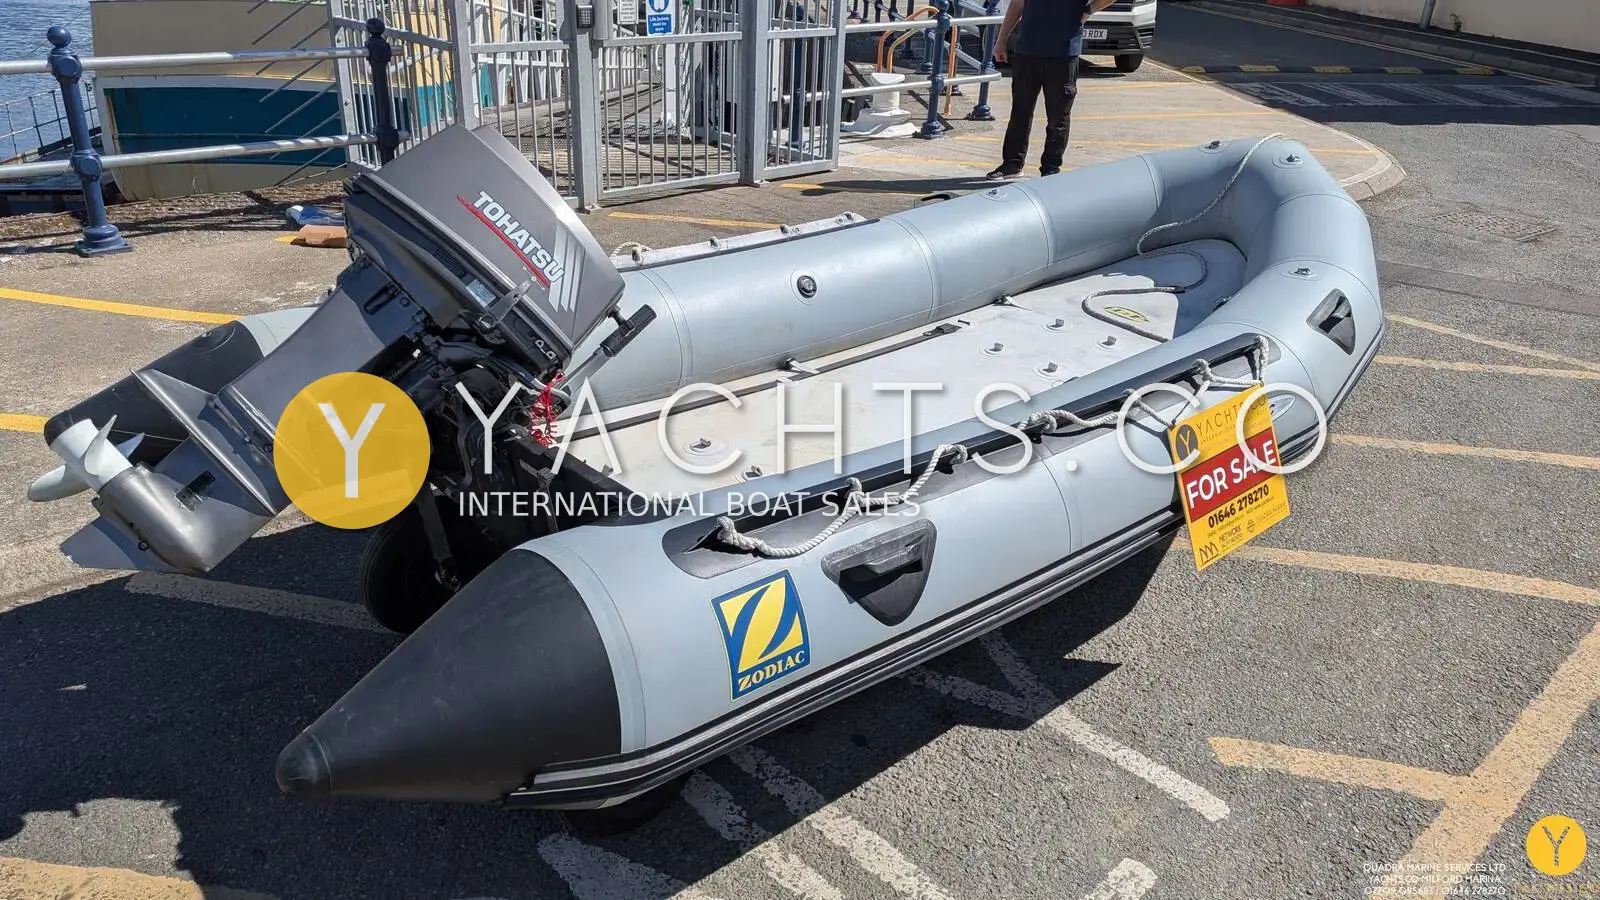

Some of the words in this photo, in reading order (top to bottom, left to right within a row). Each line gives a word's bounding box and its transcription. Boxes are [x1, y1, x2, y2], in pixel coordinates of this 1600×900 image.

[473, 190, 565, 282] TOHATSU
[1186, 470, 1228, 509] FOR
[1208, 503, 1236, 528] 01646
[1237, 484, 1269, 512] 278270
[738, 650, 805, 692] ZODIAC
